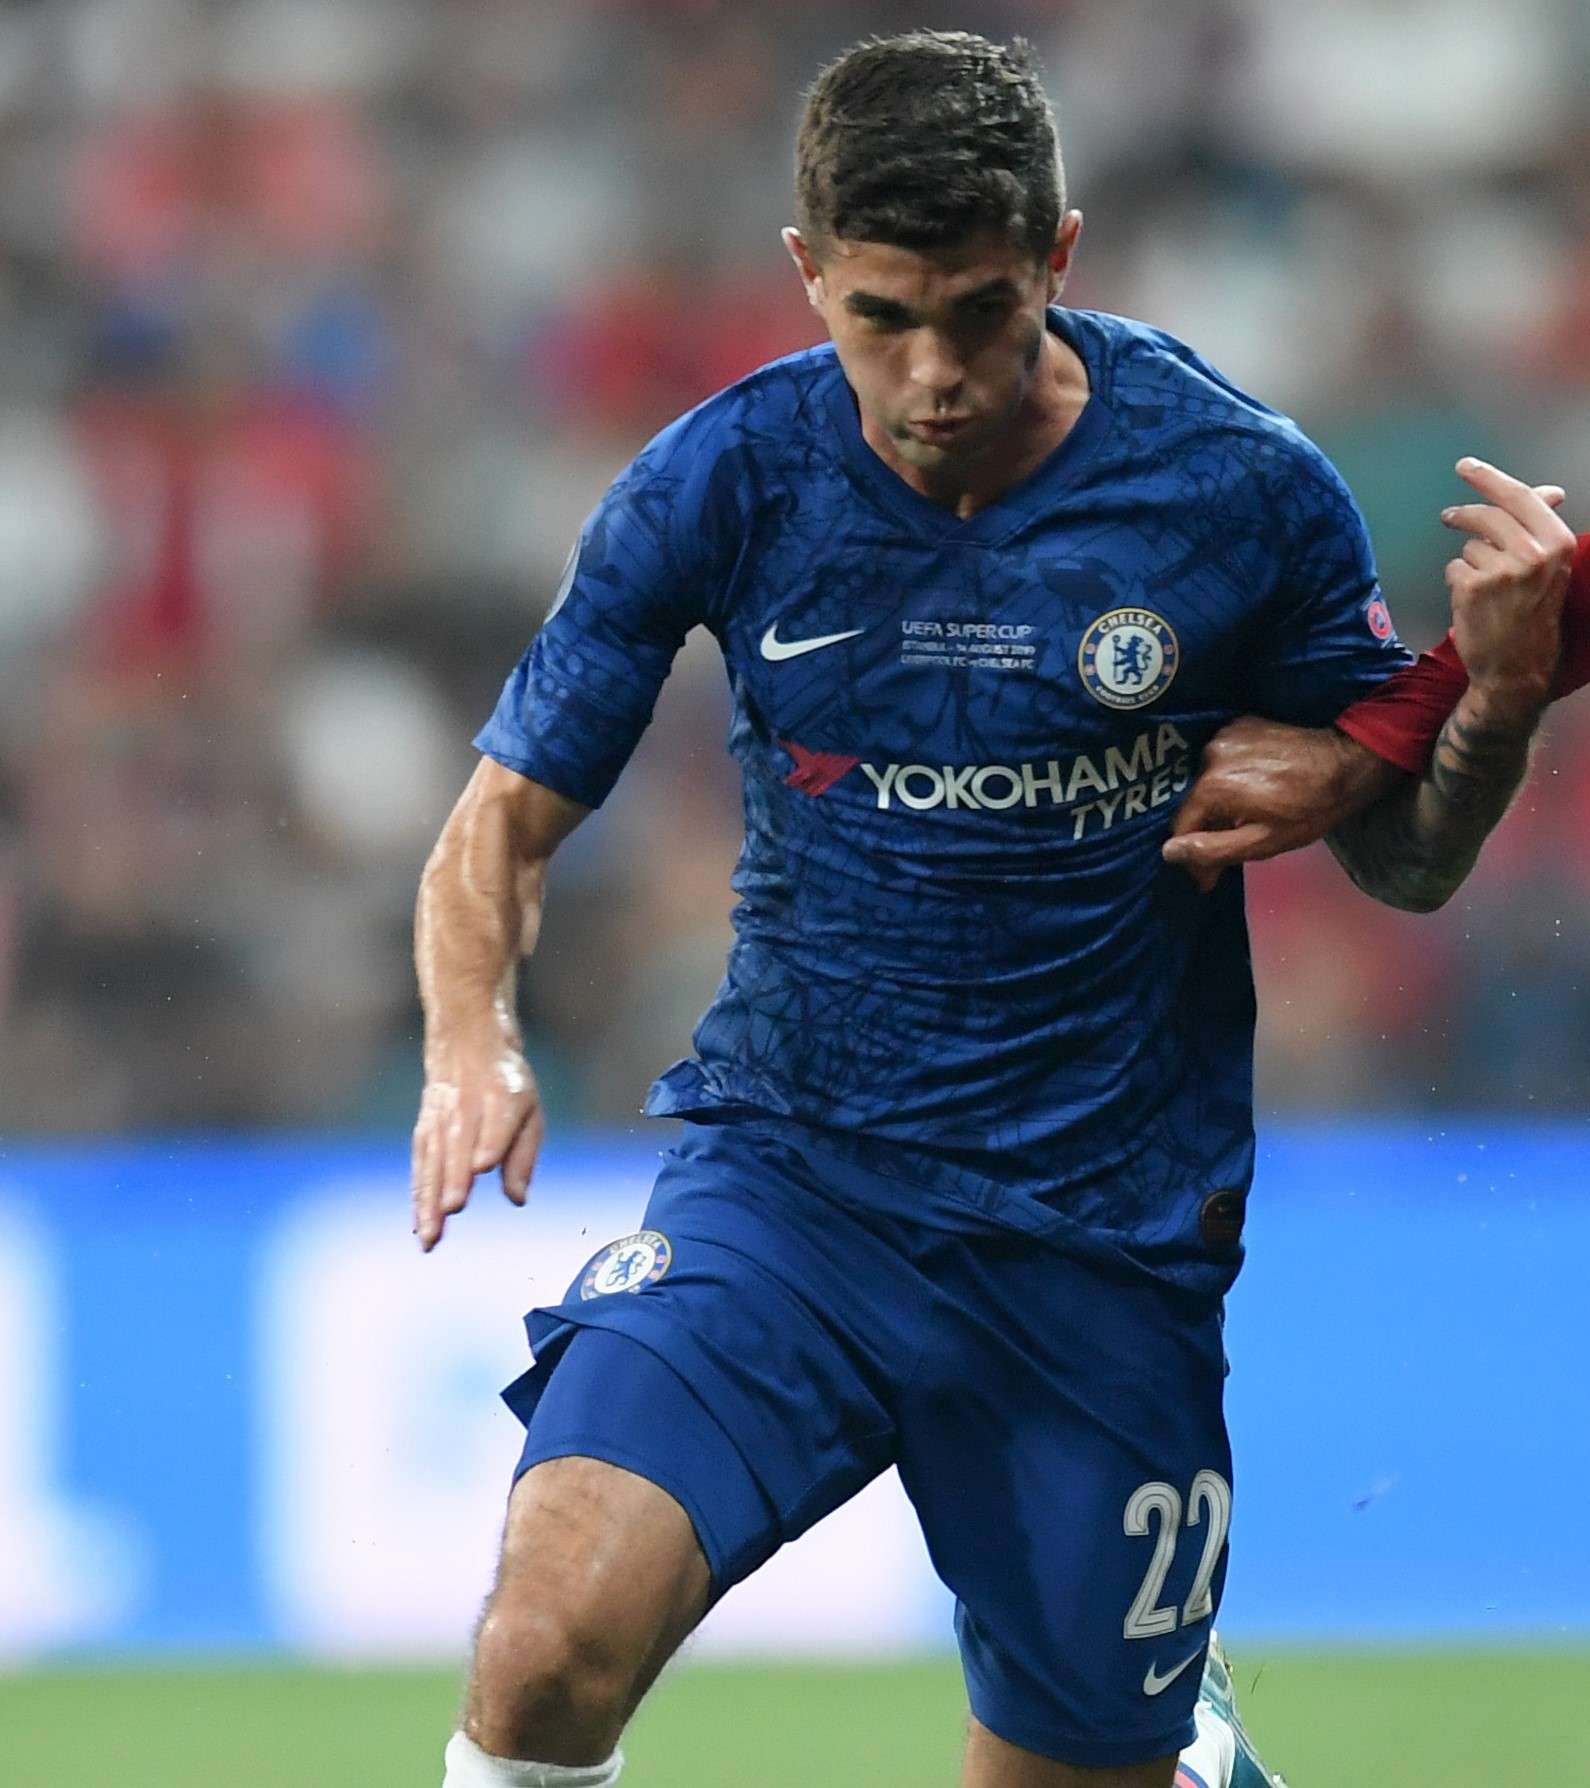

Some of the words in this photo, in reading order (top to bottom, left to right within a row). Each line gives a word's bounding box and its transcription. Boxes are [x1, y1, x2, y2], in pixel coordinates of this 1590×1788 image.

[902, 621, 943, 637] UEFA
[946, 623, 997, 639] SUPER
[998, 625, 1032, 639] CUP
[1098, 613, 1162, 635] CHELSEA
[860, 723, 1188, 809] YOKOHAMA
[1070, 754, 1189, 840] TYRES
[1122, 1469, 1233, 1640] 22
